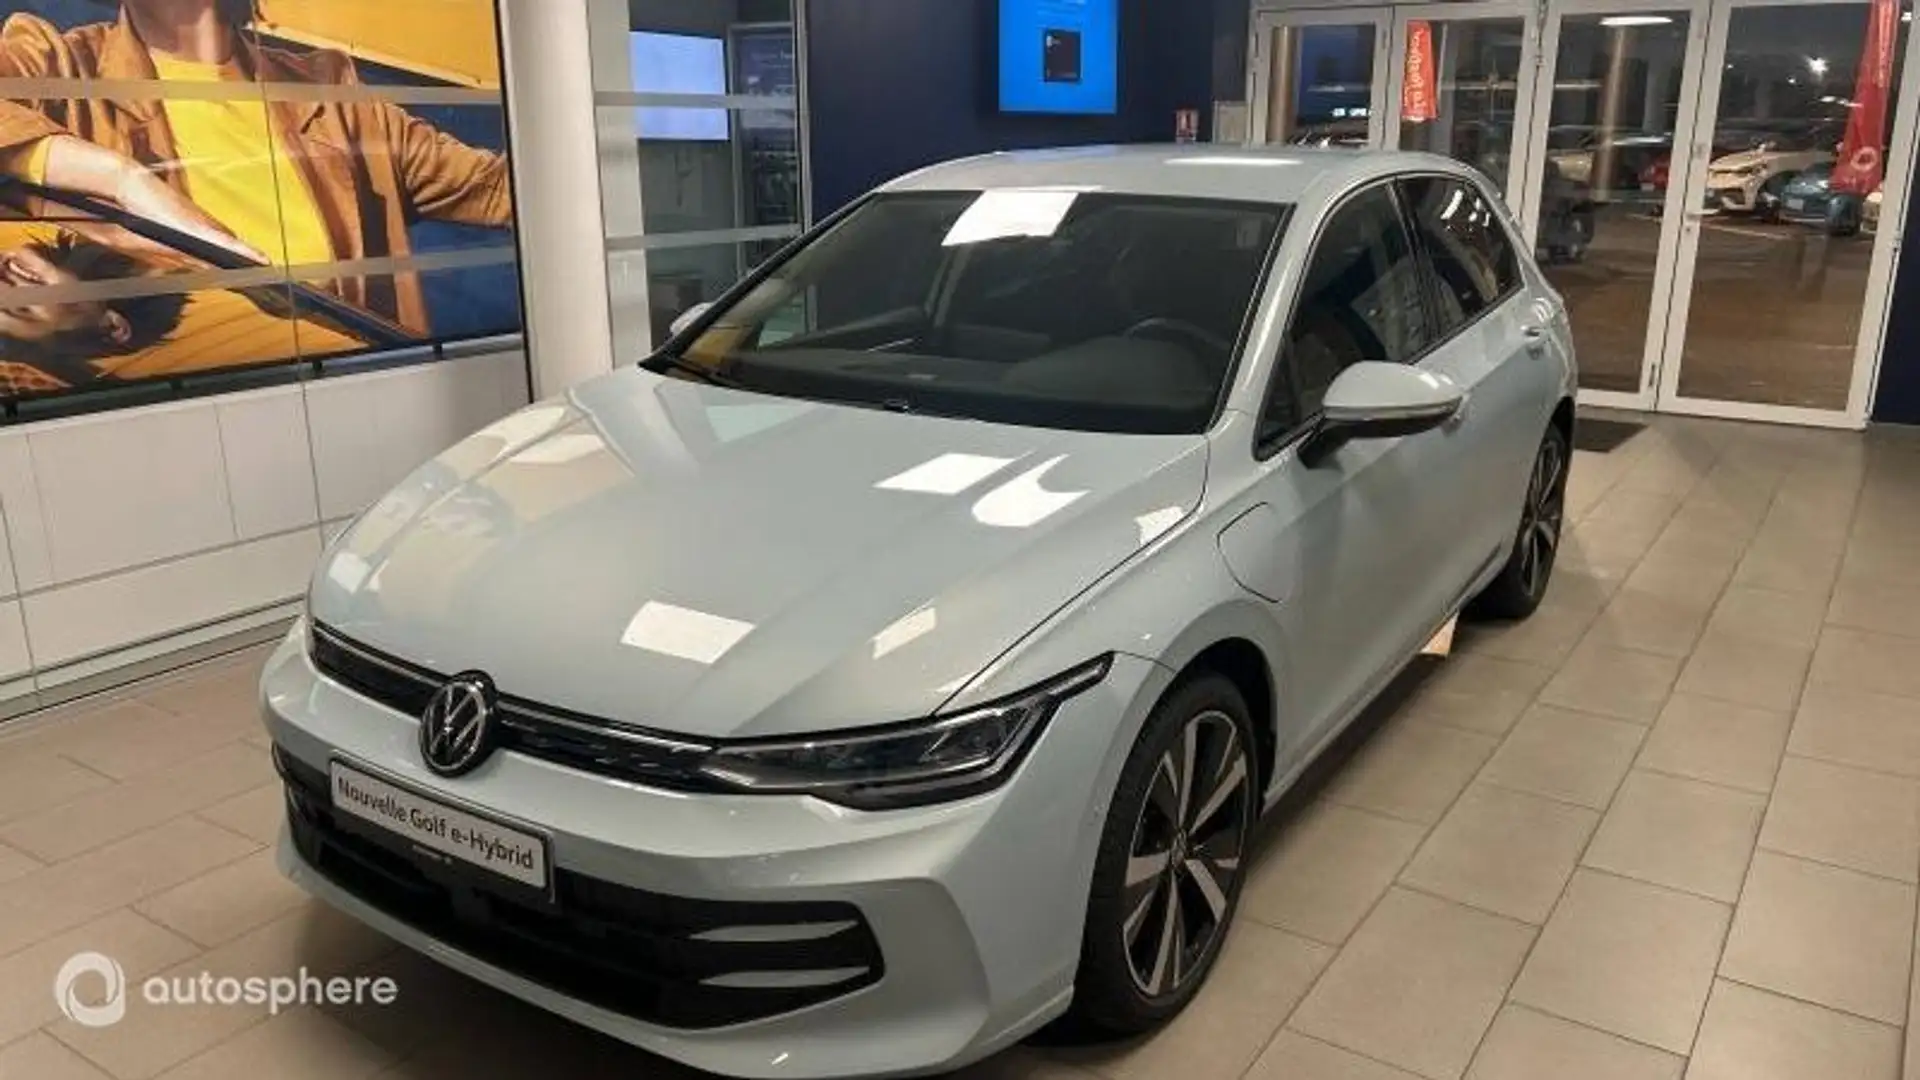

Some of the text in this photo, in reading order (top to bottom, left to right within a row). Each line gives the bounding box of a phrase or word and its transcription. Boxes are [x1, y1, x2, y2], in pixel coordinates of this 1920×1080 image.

[338, 777, 534, 869] Nouvelle Golf e-Hybrid
